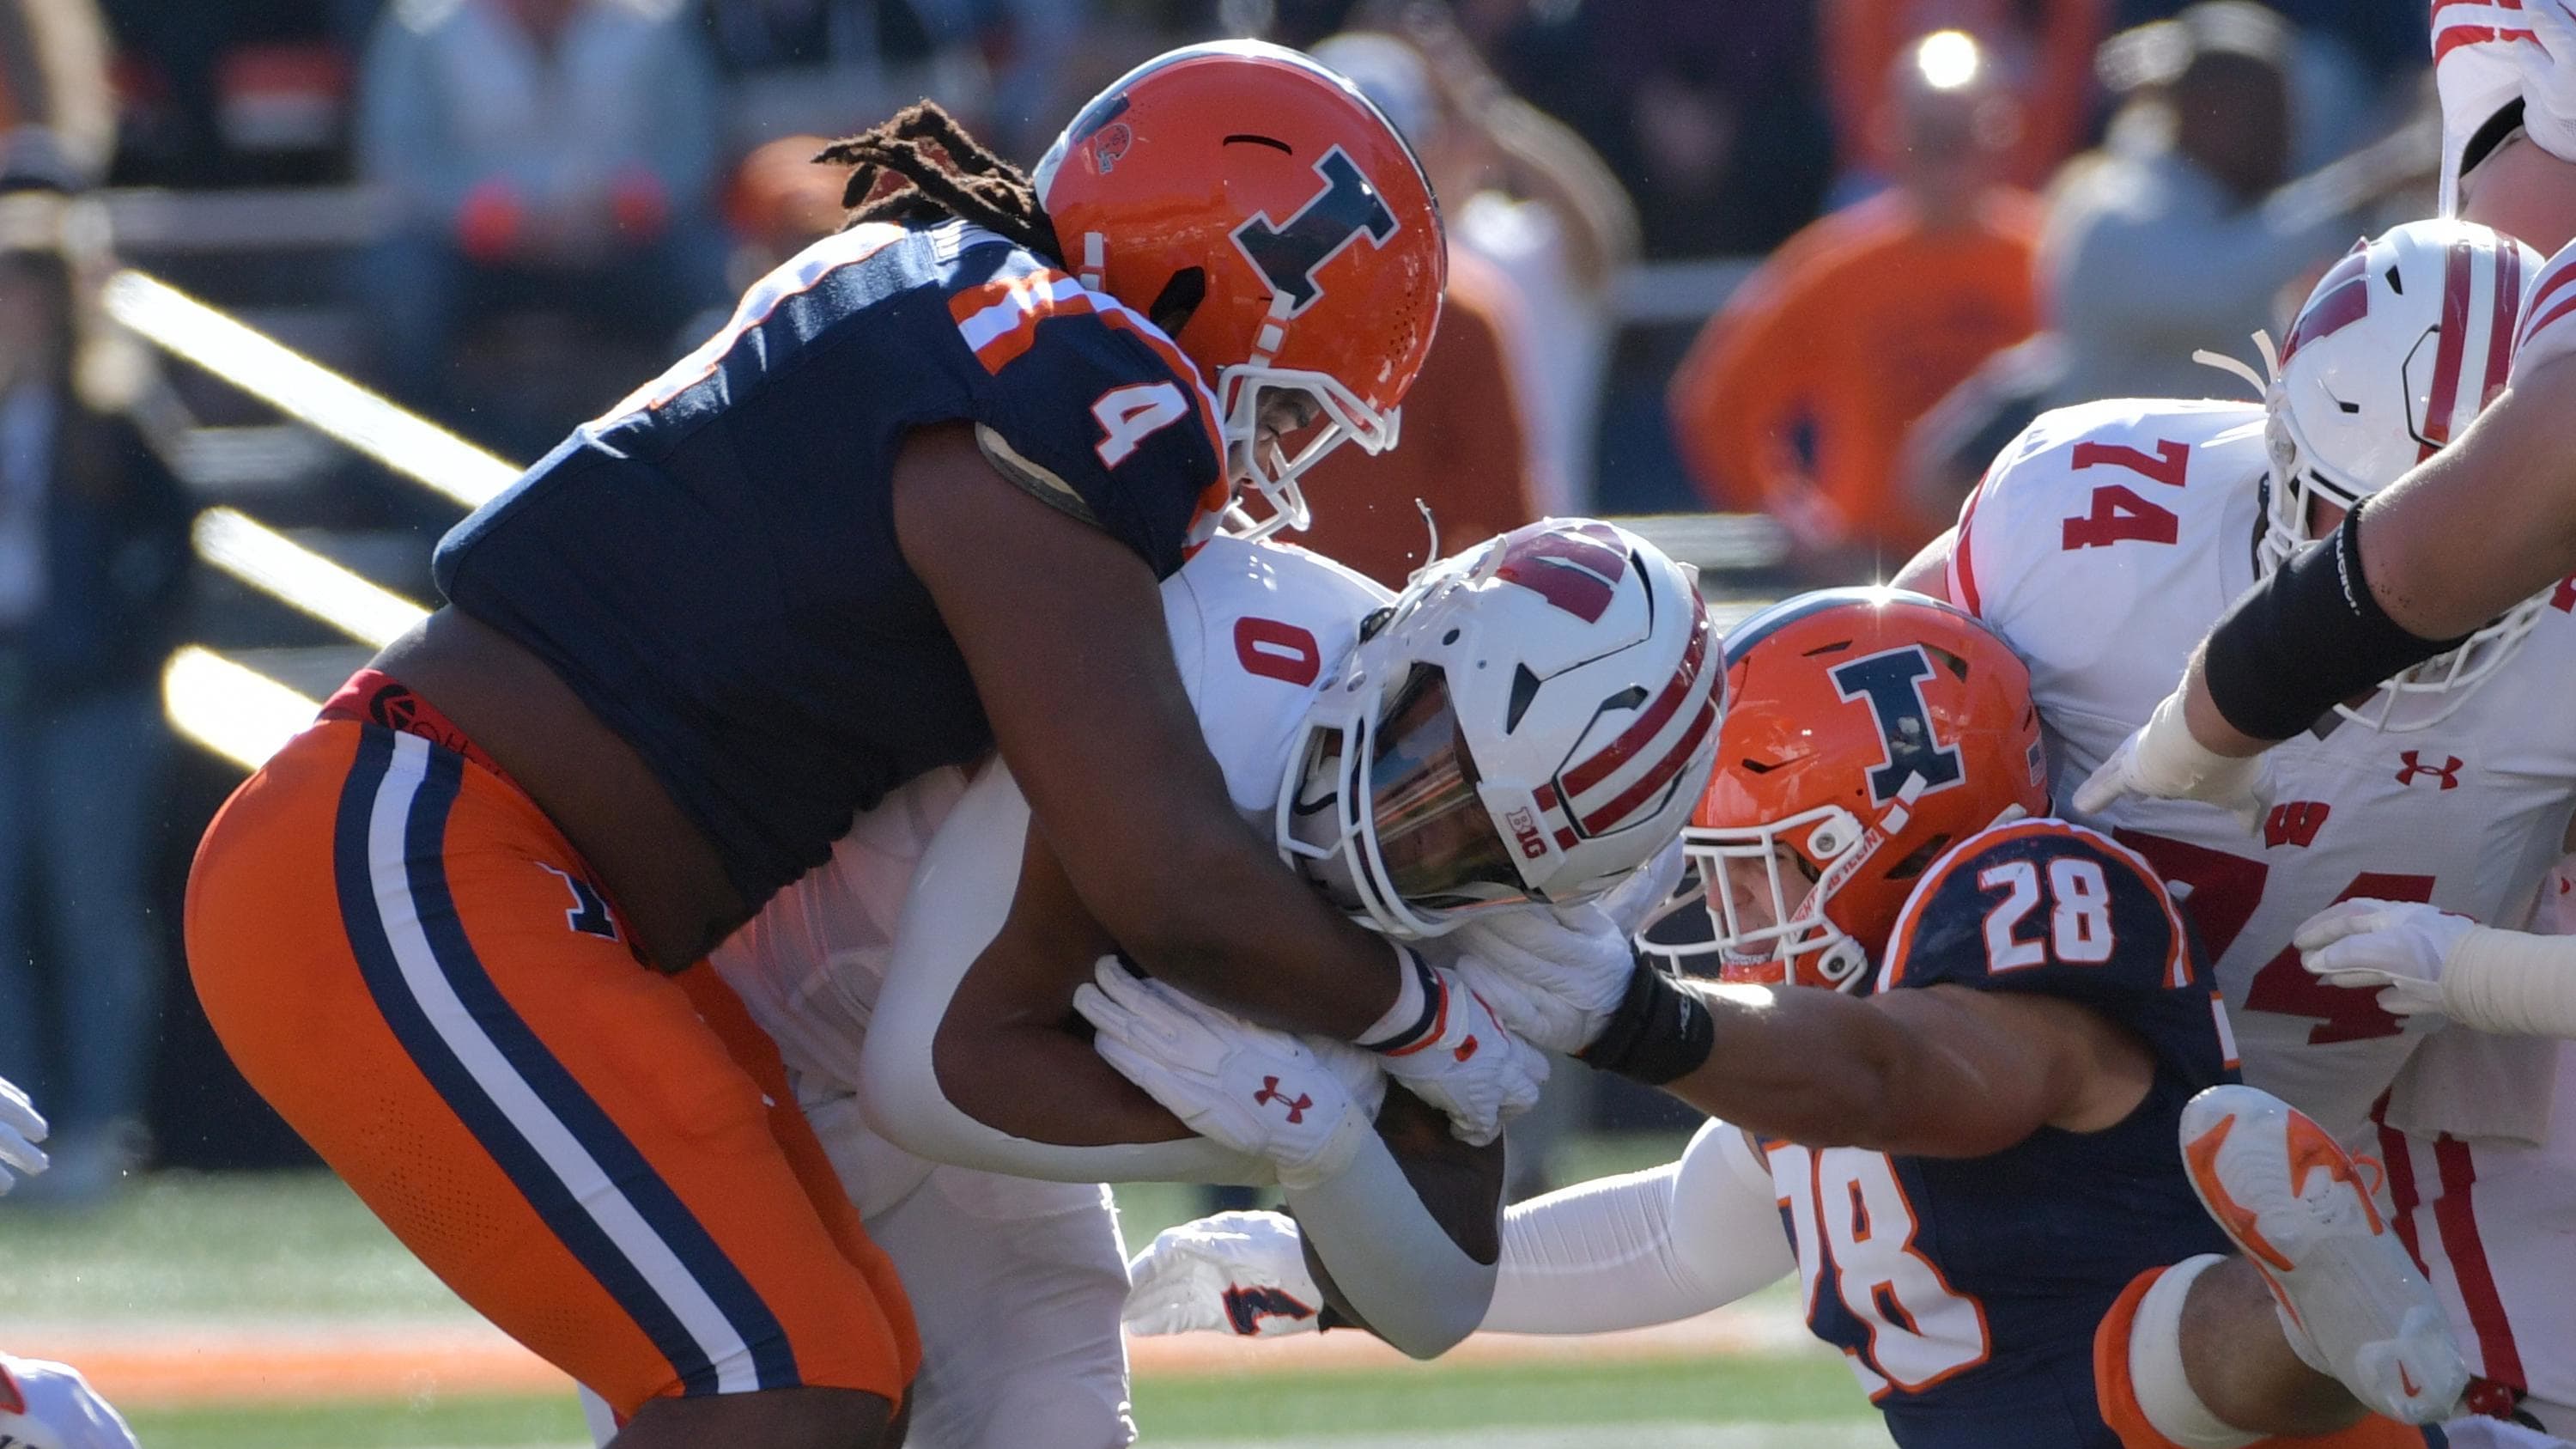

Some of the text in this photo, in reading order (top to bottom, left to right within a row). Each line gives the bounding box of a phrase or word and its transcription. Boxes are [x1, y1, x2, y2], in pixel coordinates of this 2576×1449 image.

[1229, 143, 1400, 320] I
[1090, 380, 1190, 471] 4
[2062, 439, 2190, 551] 74
[1234, 617, 1321, 687] 0
[1826, 644, 1965, 809] I
[2263, 801, 2330, 849] W
[1978, 855, 2119, 977] 28
